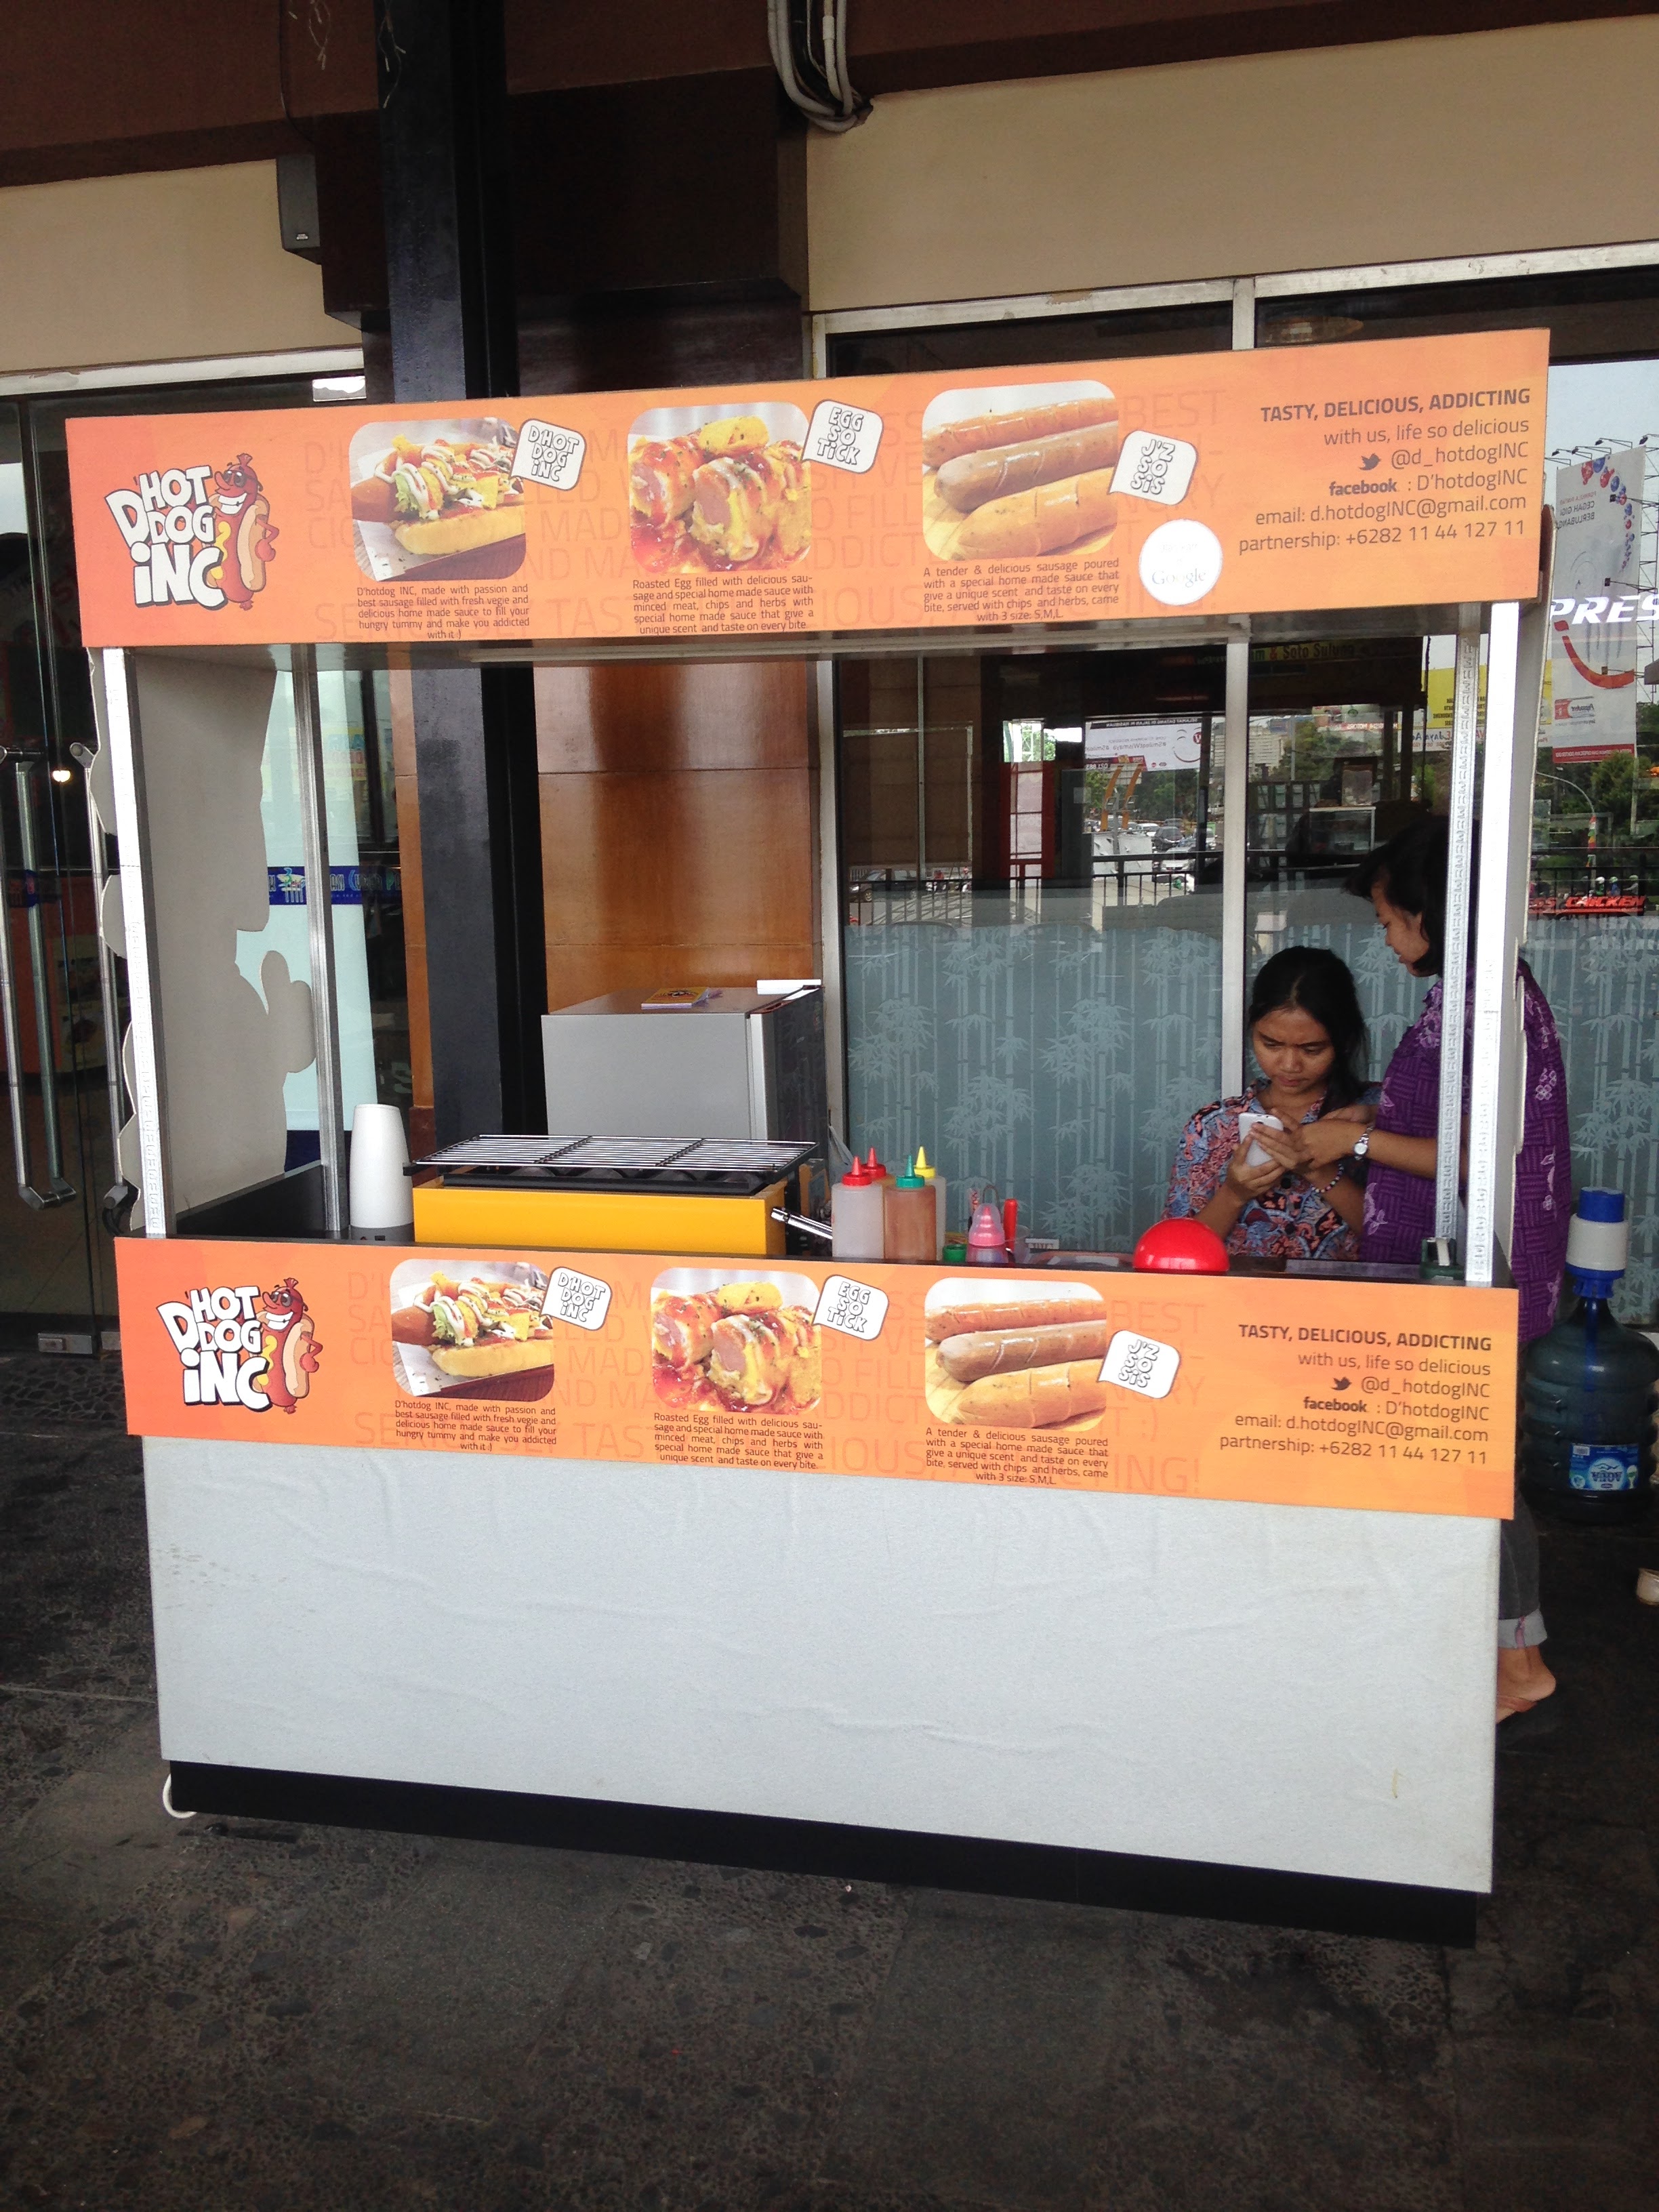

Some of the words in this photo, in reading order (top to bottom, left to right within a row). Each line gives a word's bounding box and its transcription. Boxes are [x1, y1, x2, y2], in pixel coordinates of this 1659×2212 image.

[1261, 404, 1317, 422] TASTY,
[1325, 396, 1423, 418] DELICIOUS,
[1429, 388, 1530, 409] ADDICTING
[829, 407, 864, 432] EGG
[827, 425, 856, 446] SO
[1324, 428, 1360, 445] with
[1367, 430, 1390, 443] us,
[1397, 425, 1421, 440] life
[1427, 426, 1447, 438] so
[1453, 419, 1529, 437] delicious
[532, 443, 569, 468] DOG
[1141, 439, 1175, 462] J'Z
[1391, 442, 1528, 469] @d_hotdogINC
[1137, 455, 1168, 477] SO
[1329, 478, 1397, 496] facebook
[1418, 468, 1527, 491] D'hotdogINC
[1256, 510, 1305, 525] email:
[1311, 496, 1525, 522] d.hotdogINC@gmail.com
[146, 506, 216, 544] DOG
[1240, 531, 1339, 555] partnership:
[1346, 528, 1401, 544] +6282
[1409, 526, 1428, 541] 11
[1435, 525, 1457, 539] 44
[1465, 522, 1496, 537] 127
[1504, 520, 1523, 535] 11
[1152, 568, 1206, 588] Google
[357, 587, 395, 597] D'hotdog
[400, 586, 417, 596] INC,
[422, 586, 446, 594] made
[451, 585, 469, 594] with
[474, 586, 507, 596] passion
[512, 584, 528, 593] and
[358, 598, 375, 607] best
[379, 599, 413, 608] sausage
[417, 596, 437, 605] filled
[440, 596, 459, 605] with
[462, 596, 484, 605] fresh
[487, 596, 510, 606] vegie
[512, 595, 529, 604] and
[359, 609, 394, 618] delicious
[398, 609, 422, 617] home
[426, 608, 451, 617] made
[495, 607, 506, 615] fill
[510, 608, 529, 617] your
[359, 620, 388, 630] hungry
[392, 620, 422, 630] tummy
[426, 619, 442, 628] and
[446, 618, 470, 627] make
[473, 620, 489, 629] you
[493, 617, 529, 626] addicted
[977, 611, 998, 621] with
[1002, 611, 1007, 620] 3
[1010, 611, 1031, 619] size:
[427, 630, 447, 638] with
[455, 630, 462, 640] :)
[561, 1287, 596, 1311] DOG
[838, 1282, 871, 1305] EGG
[837, 1296, 863, 1316] SO
[197, 1319, 263, 1354] DOG
[1239, 1324, 1292, 1341] TASTY,
[1298, 1328, 1391, 1347] DELICIOUS,
[1397, 1333, 1491, 1351] ADDICTING
[1128, 1339, 1160, 1361] J'Z
[1124, 1353, 1153, 1373] SO
[1298, 1353, 1333, 1366] with
[1338, 1357, 1361, 1370] us,
[1366, 1355, 1390, 1370] life
[1395, 1360, 1413, 1371] so
[1419, 1358, 1490, 1375] delicious
[1361, 1376, 1490, 1399] @d_hotdogINC
[654, 1412, 689, 1422] Roasted
[693, 1414, 709, 1426] Egg
[713, 1415, 733, 1425] filled
[738, 1417, 756, 1425] with
[761, 1418, 798, 1427] delicious
[1304, 1397, 1367, 1412] facebook
[1387, 1401, 1489, 1422] D'hotdogINC
[654, 1425, 674, 1434] sage
[676, 1424, 692, 1433] and
[693, 1426, 722, 1435] special
[724, 1426, 749, 1435] home
[751, 1428, 775, 1437] made
[803, 1431, 823, 1439] with
[1235, 1414, 1281, 1428] email:
[1287, 1416, 1488, 1442] d.hotdogINC@gmail.com
[655, 1433, 685, 1442] minced
[691, 1436, 715, 1445] meat,
[722, 1436, 744, 1448] chips
[750, 1438, 766, 1446] and
[773, 1439, 797, 1448] herbs
[804, 1441, 823, 1449] with
[655, 1443, 683, 1453] special
[688, 1443, 712, 1453] home
[716, 1446, 741, 1454] made
[774, 1448, 792, 1457] that
[796, 1450, 813, 1460] give
[1221, 1435, 1314, 1455] partnership:
[1319, 1441, 1371, 1456] +6282
[1379, 1445, 1397, 1458] 11
[1403, 1446, 1423, 1459] 44
[1431, 1448, 1460, 1462] 127
[1469, 1451, 1486, 1464] 11
[660, 1453, 689, 1464] unique
[718, 1456, 734, 1465] and
[736, 1457, 758, 1466] taste
[774, 1460, 797, 1471] every
[800, 1460, 819, 1469] bite.
